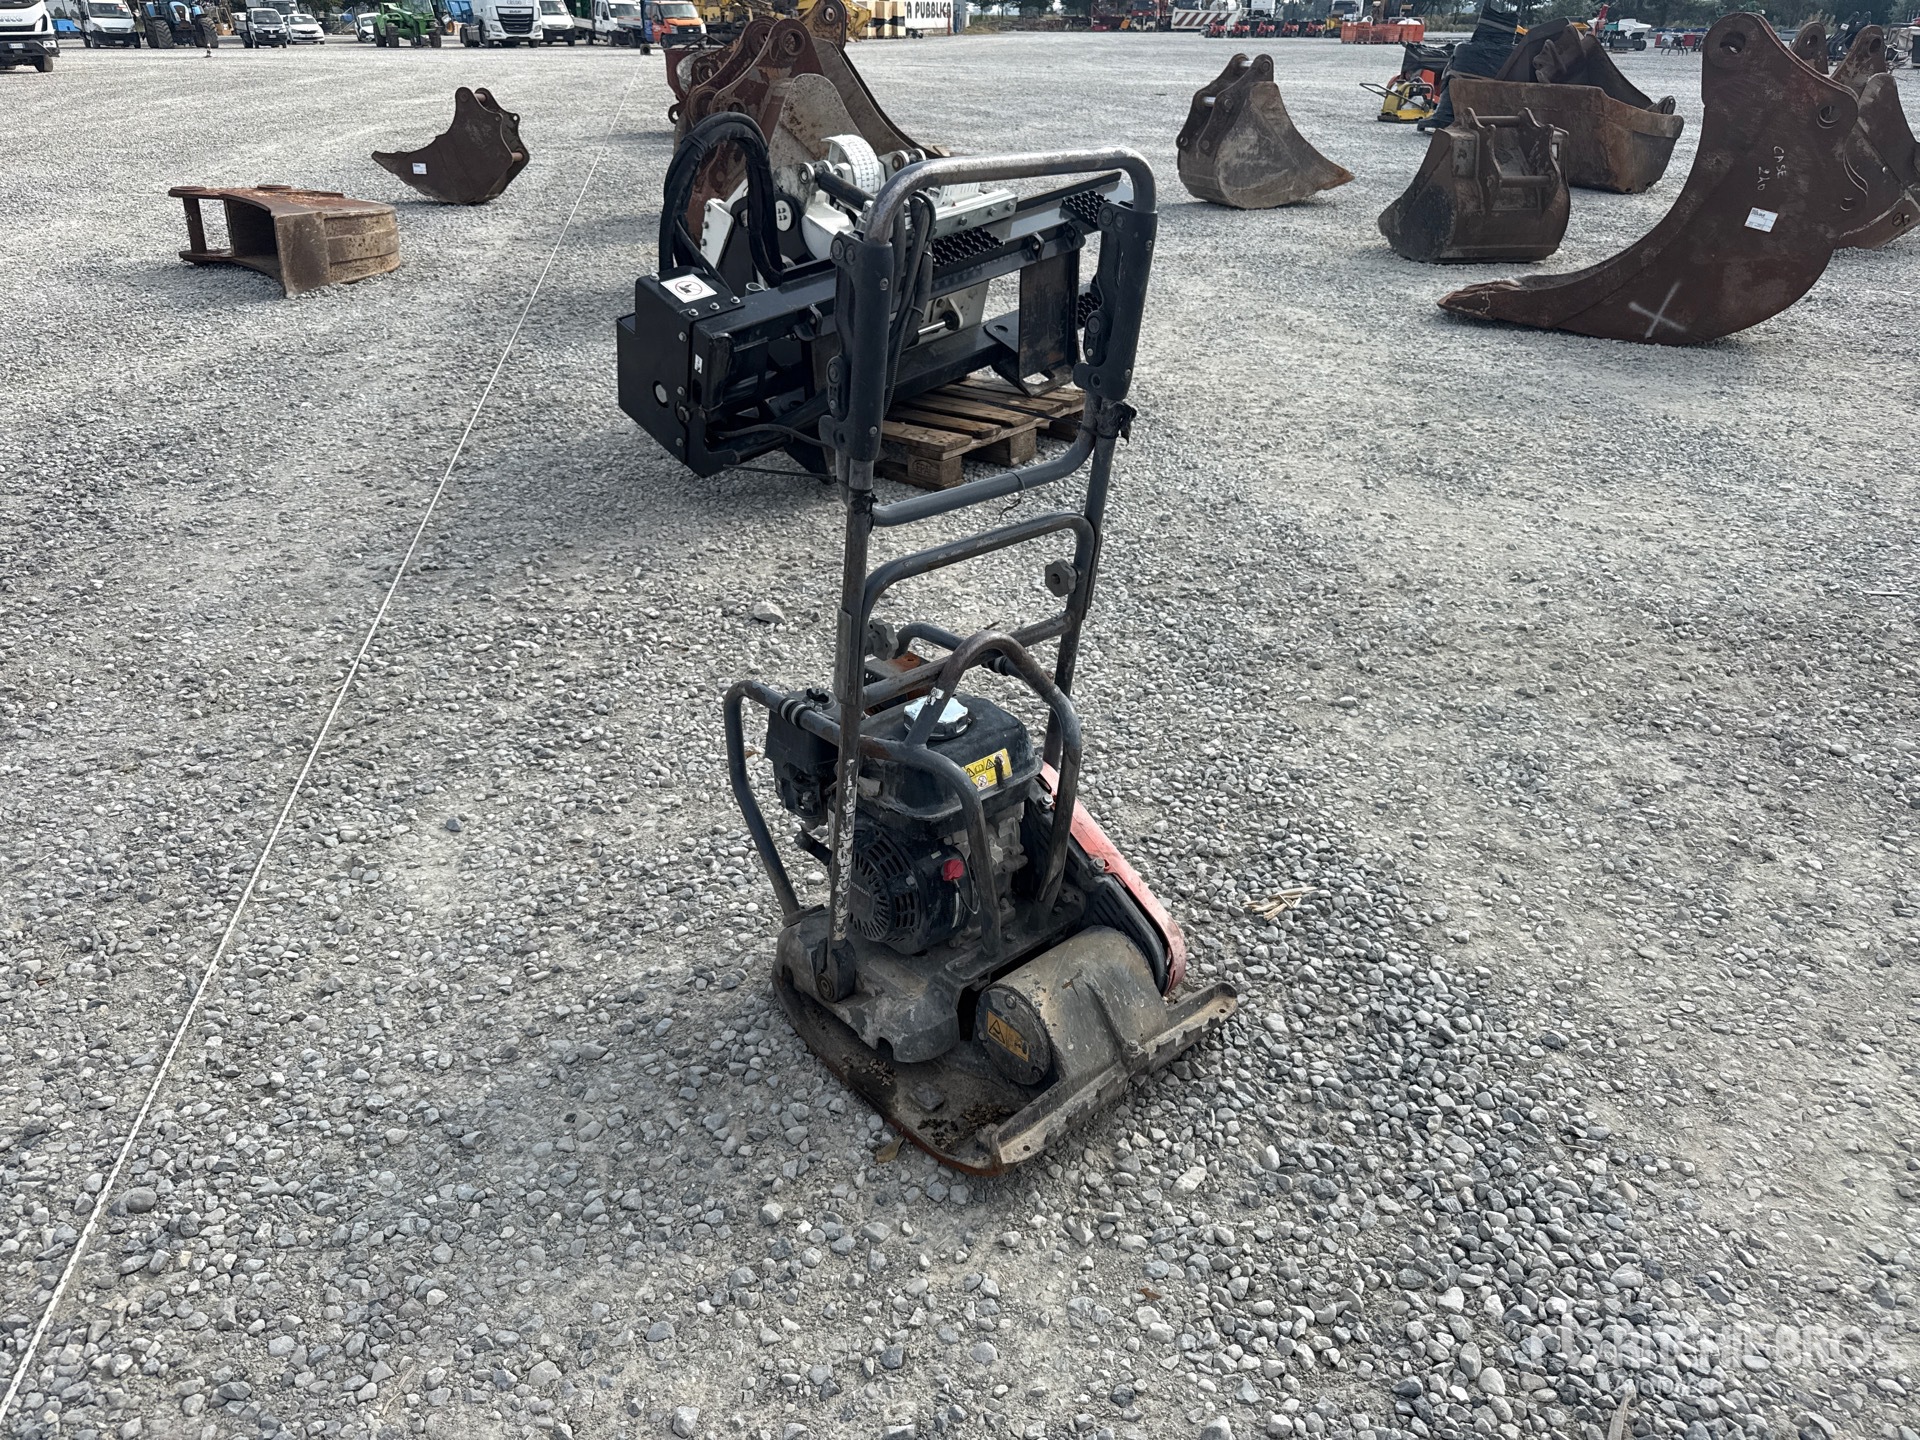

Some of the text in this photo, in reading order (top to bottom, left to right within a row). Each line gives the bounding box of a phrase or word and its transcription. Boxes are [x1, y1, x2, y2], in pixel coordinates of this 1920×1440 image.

[915, 1, 951, 19] PUBBLICA
[1773, 145, 1786, 179] CASE
[851, 881, 871, 898] ONDA
